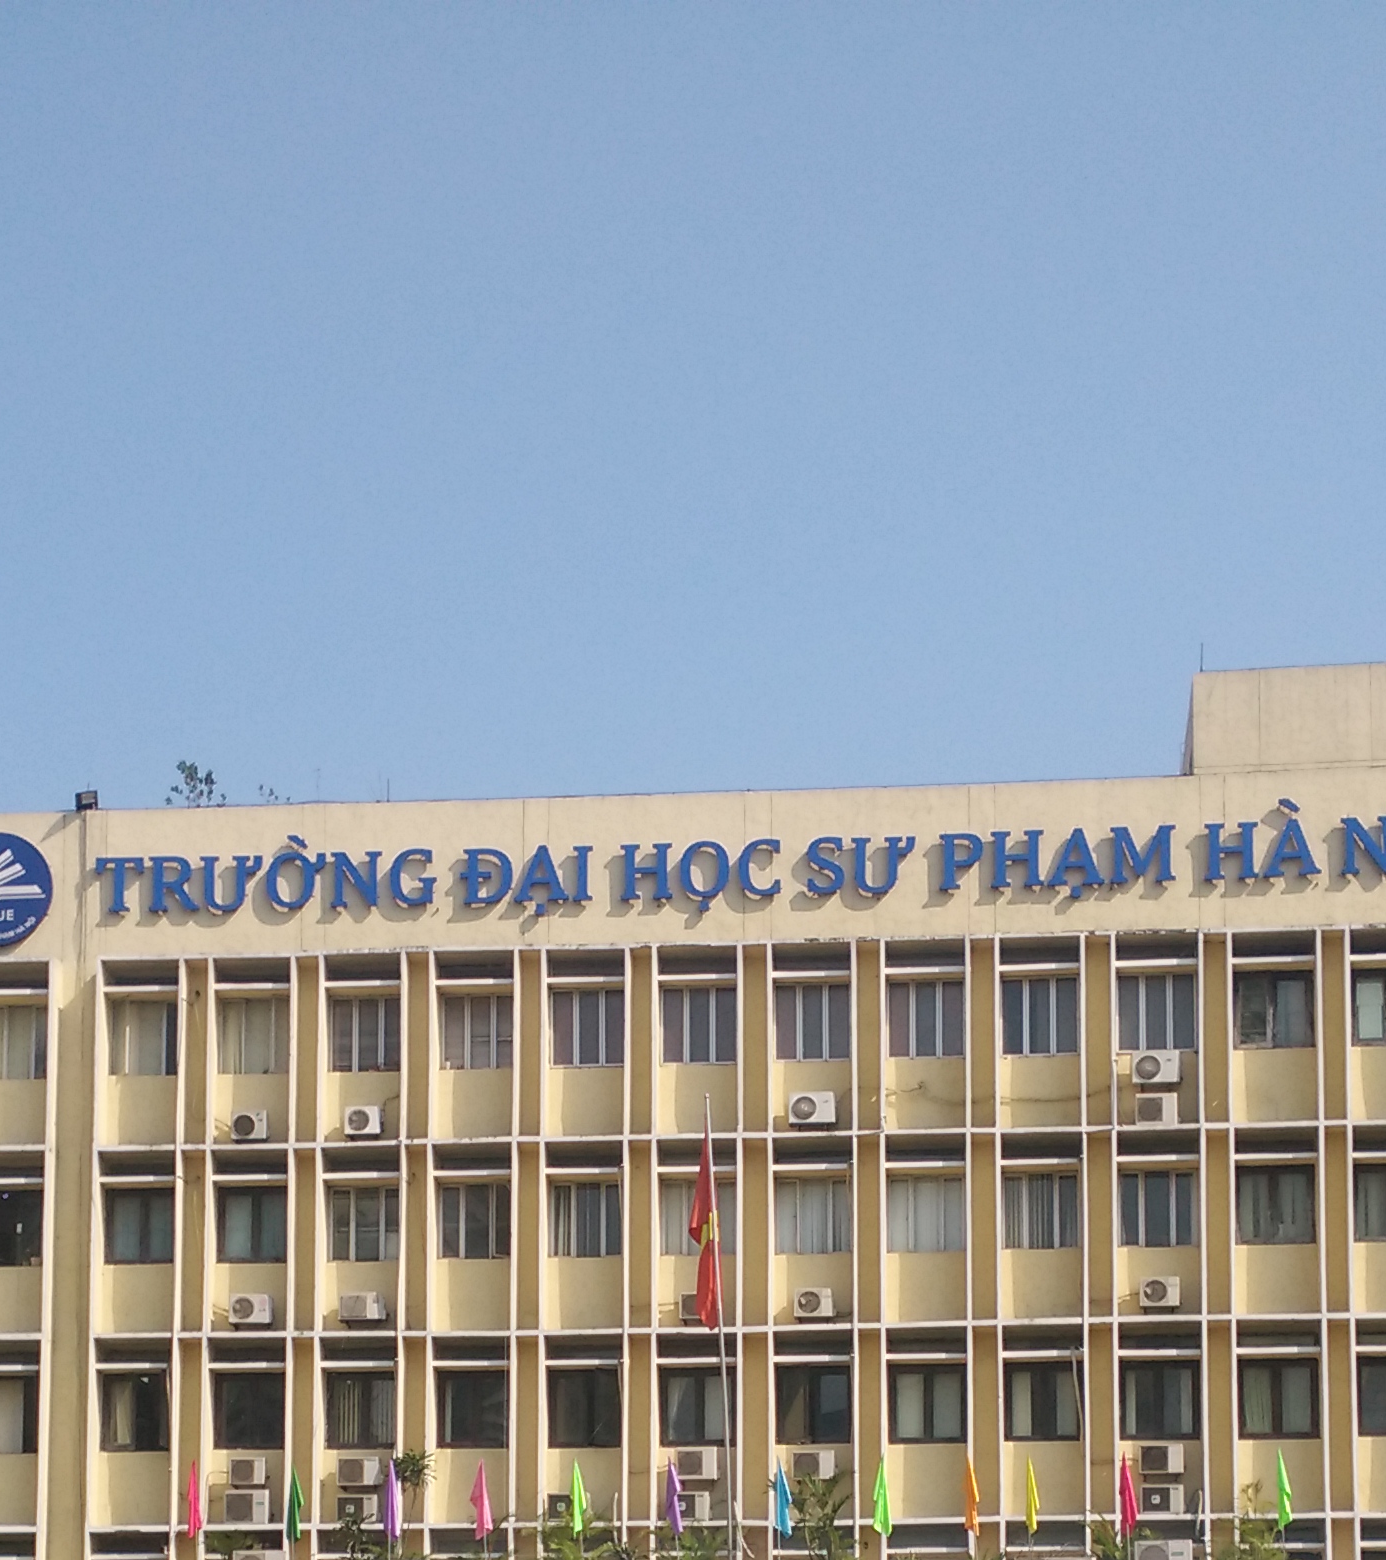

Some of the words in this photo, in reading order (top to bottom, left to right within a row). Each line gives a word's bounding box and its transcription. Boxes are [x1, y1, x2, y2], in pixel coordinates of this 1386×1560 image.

[95, 834, 437, 915] TRƯỜNG
[459, 844, 594, 916] ĐẠI
[619, 838, 782, 912] HỌC
[806, 835, 917, 895] SƯ
[938, 824, 1177, 899] PHẠM
[1204, 797, 1321, 881] HÀ
